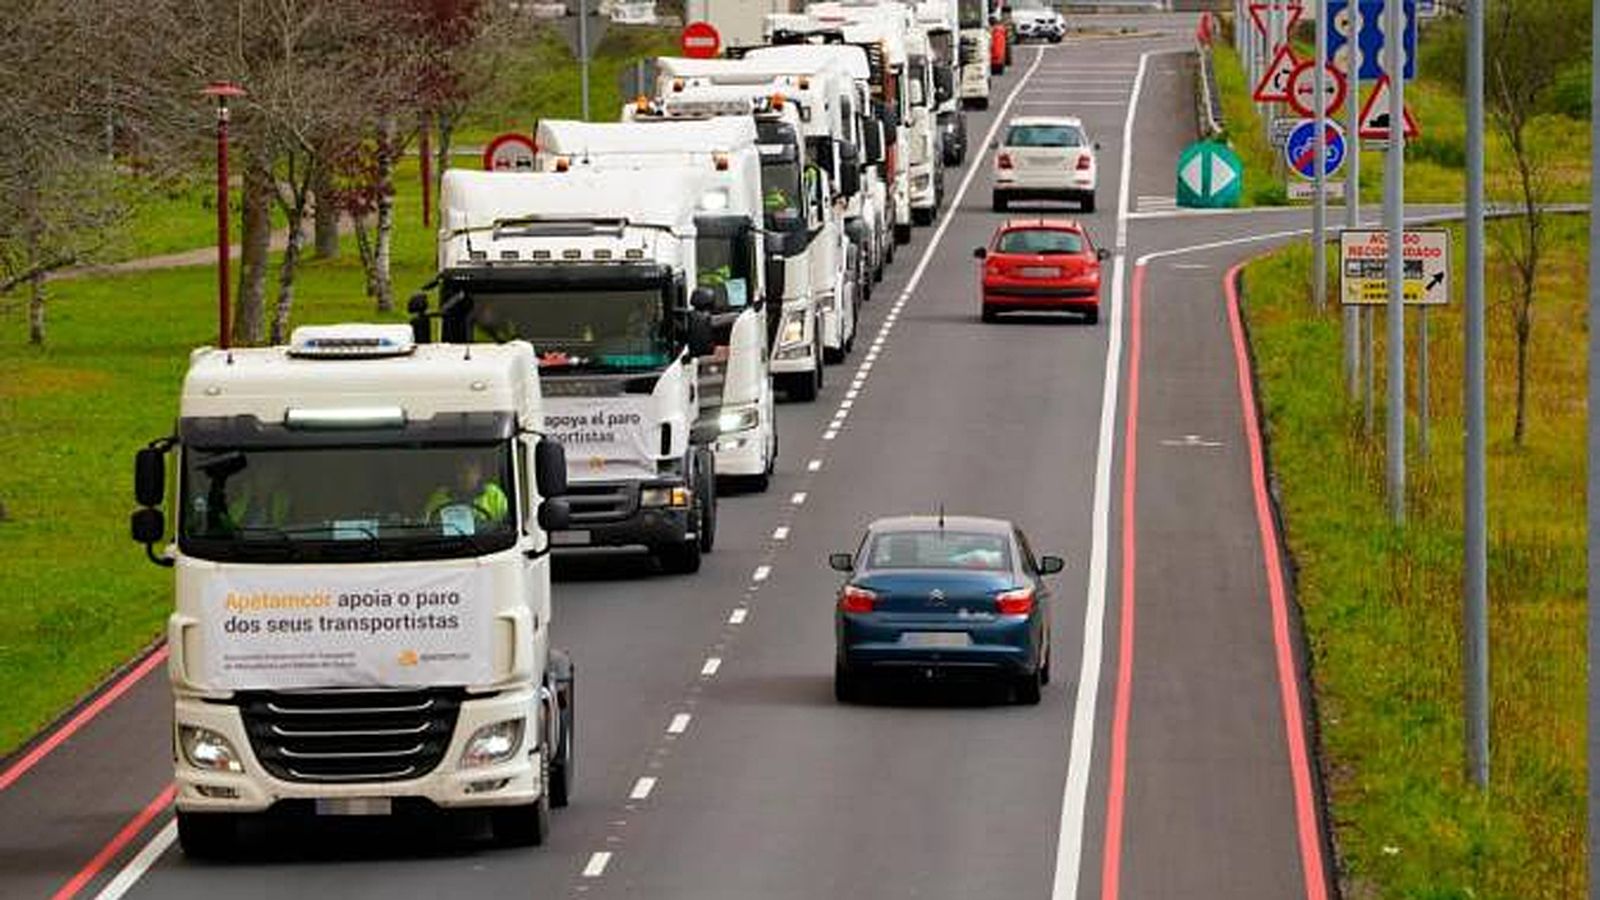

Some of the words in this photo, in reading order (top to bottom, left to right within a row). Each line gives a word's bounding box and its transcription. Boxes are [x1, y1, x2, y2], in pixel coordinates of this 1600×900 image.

[543, 414, 588, 428] apoya
[590, 410, 604, 425] el
[608, 413, 641, 428] paro
[338, 589, 392, 610] apoia
[398, 592, 410, 607] o
[416, 591, 460, 609] paro
[224, 615, 261, 634] dos
[266, 618, 314, 633] seus
[319, 613, 459, 635] transportistas
